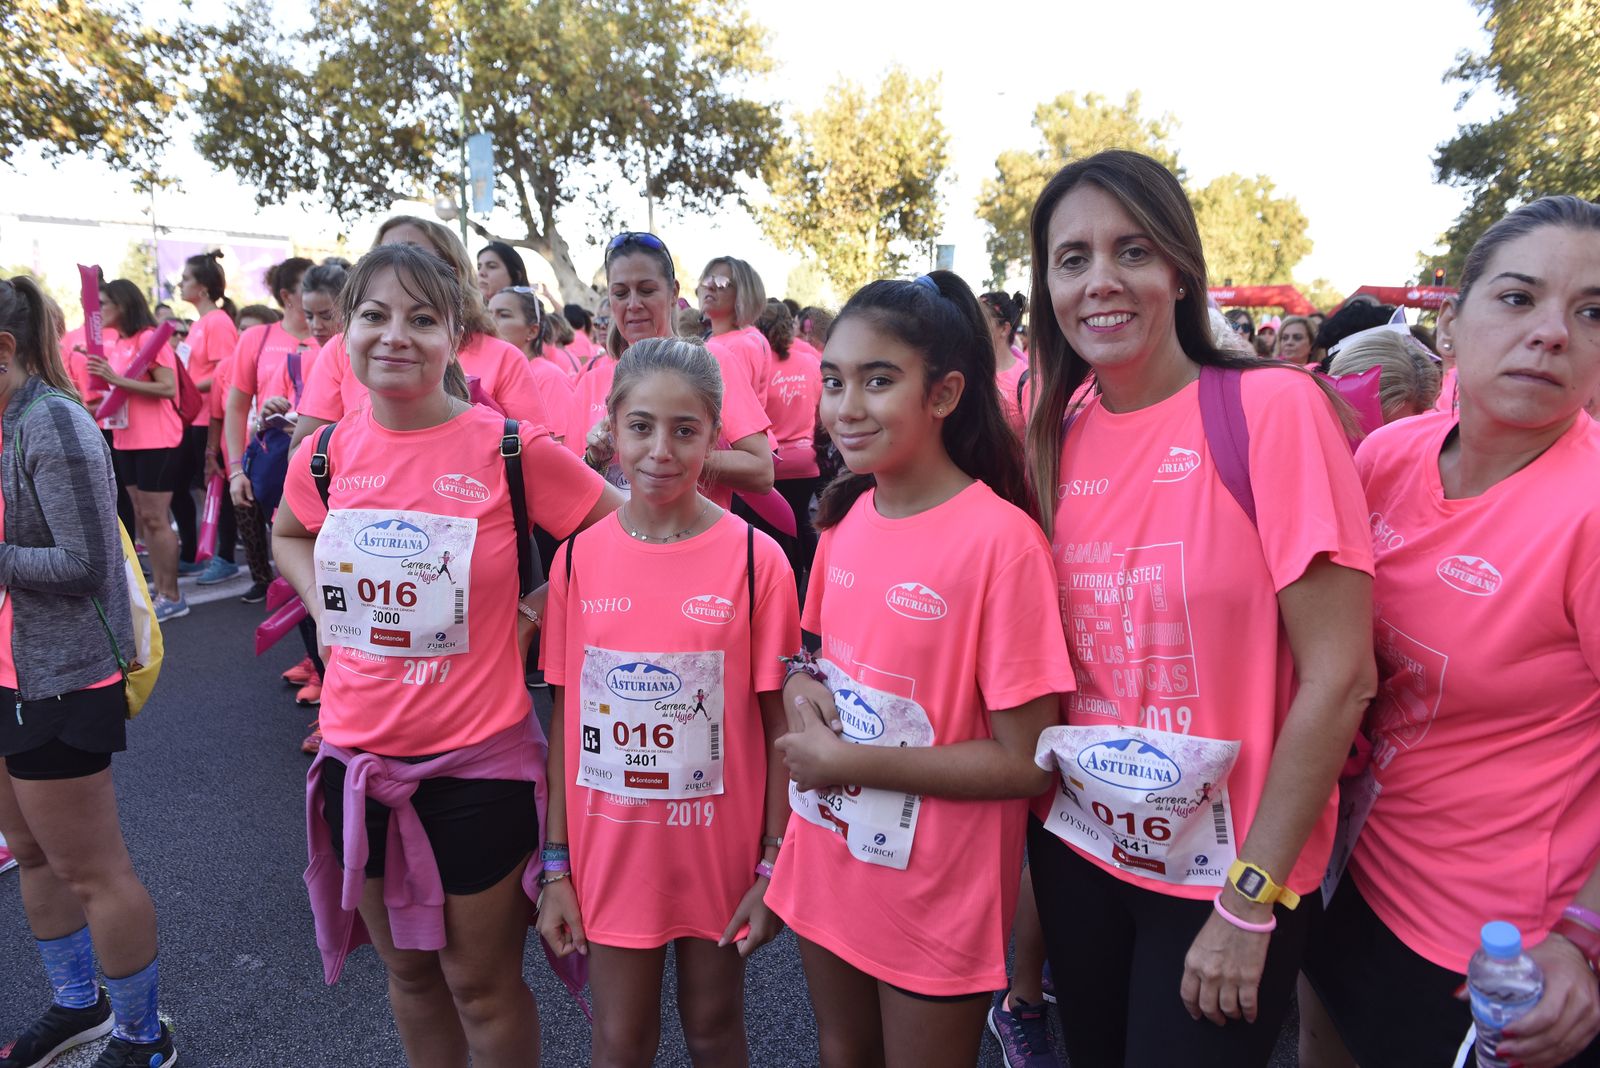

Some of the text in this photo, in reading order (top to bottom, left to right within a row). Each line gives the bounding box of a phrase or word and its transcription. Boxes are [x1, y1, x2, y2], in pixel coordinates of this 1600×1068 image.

[336, 475, 386, 492] OYSHO
[437, 480, 486, 500] ASTURIANA
[359, 532, 423, 550] ASTURIANA
[400, 558, 431, 571] Carrera
[1073, 565, 1162, 588] VITORIA GASTEIZ
[357, 578, 418, 607] 016
[888, 590, 942, 616] ASTURIANA
[372, 609, 400, 625] 3000
[330, 624, 362, 637] OYSHO
[378, 634, 405, 643] Santander
[402, 659, 452, 686] 2019
[610, 674, 676, 692] ASTURIANA
[654, 700, 687, 712] Carrera
[673, 710, 697, 725] Mujer
[612, 721, 675, 749] 016
[624, 753, 657, 767] 3401
[1085, 751, 1173, 783] ASTURIANA
[584, 765, 613, 780] OYSHO
[685, 781, 712, 790] ZURICH
[1145, 792, 1189, 806] Carrera
[666, 801, 715, 827] 2019
[1170, 803, 1199, 819] Mujer
[1060, 811, 1099, 841] OYSHO
[1092, 801, 1172, 842] 016
[861, 844, 894, 858] ZURICH
[1186, 868, 1221, 877] ZURICH
